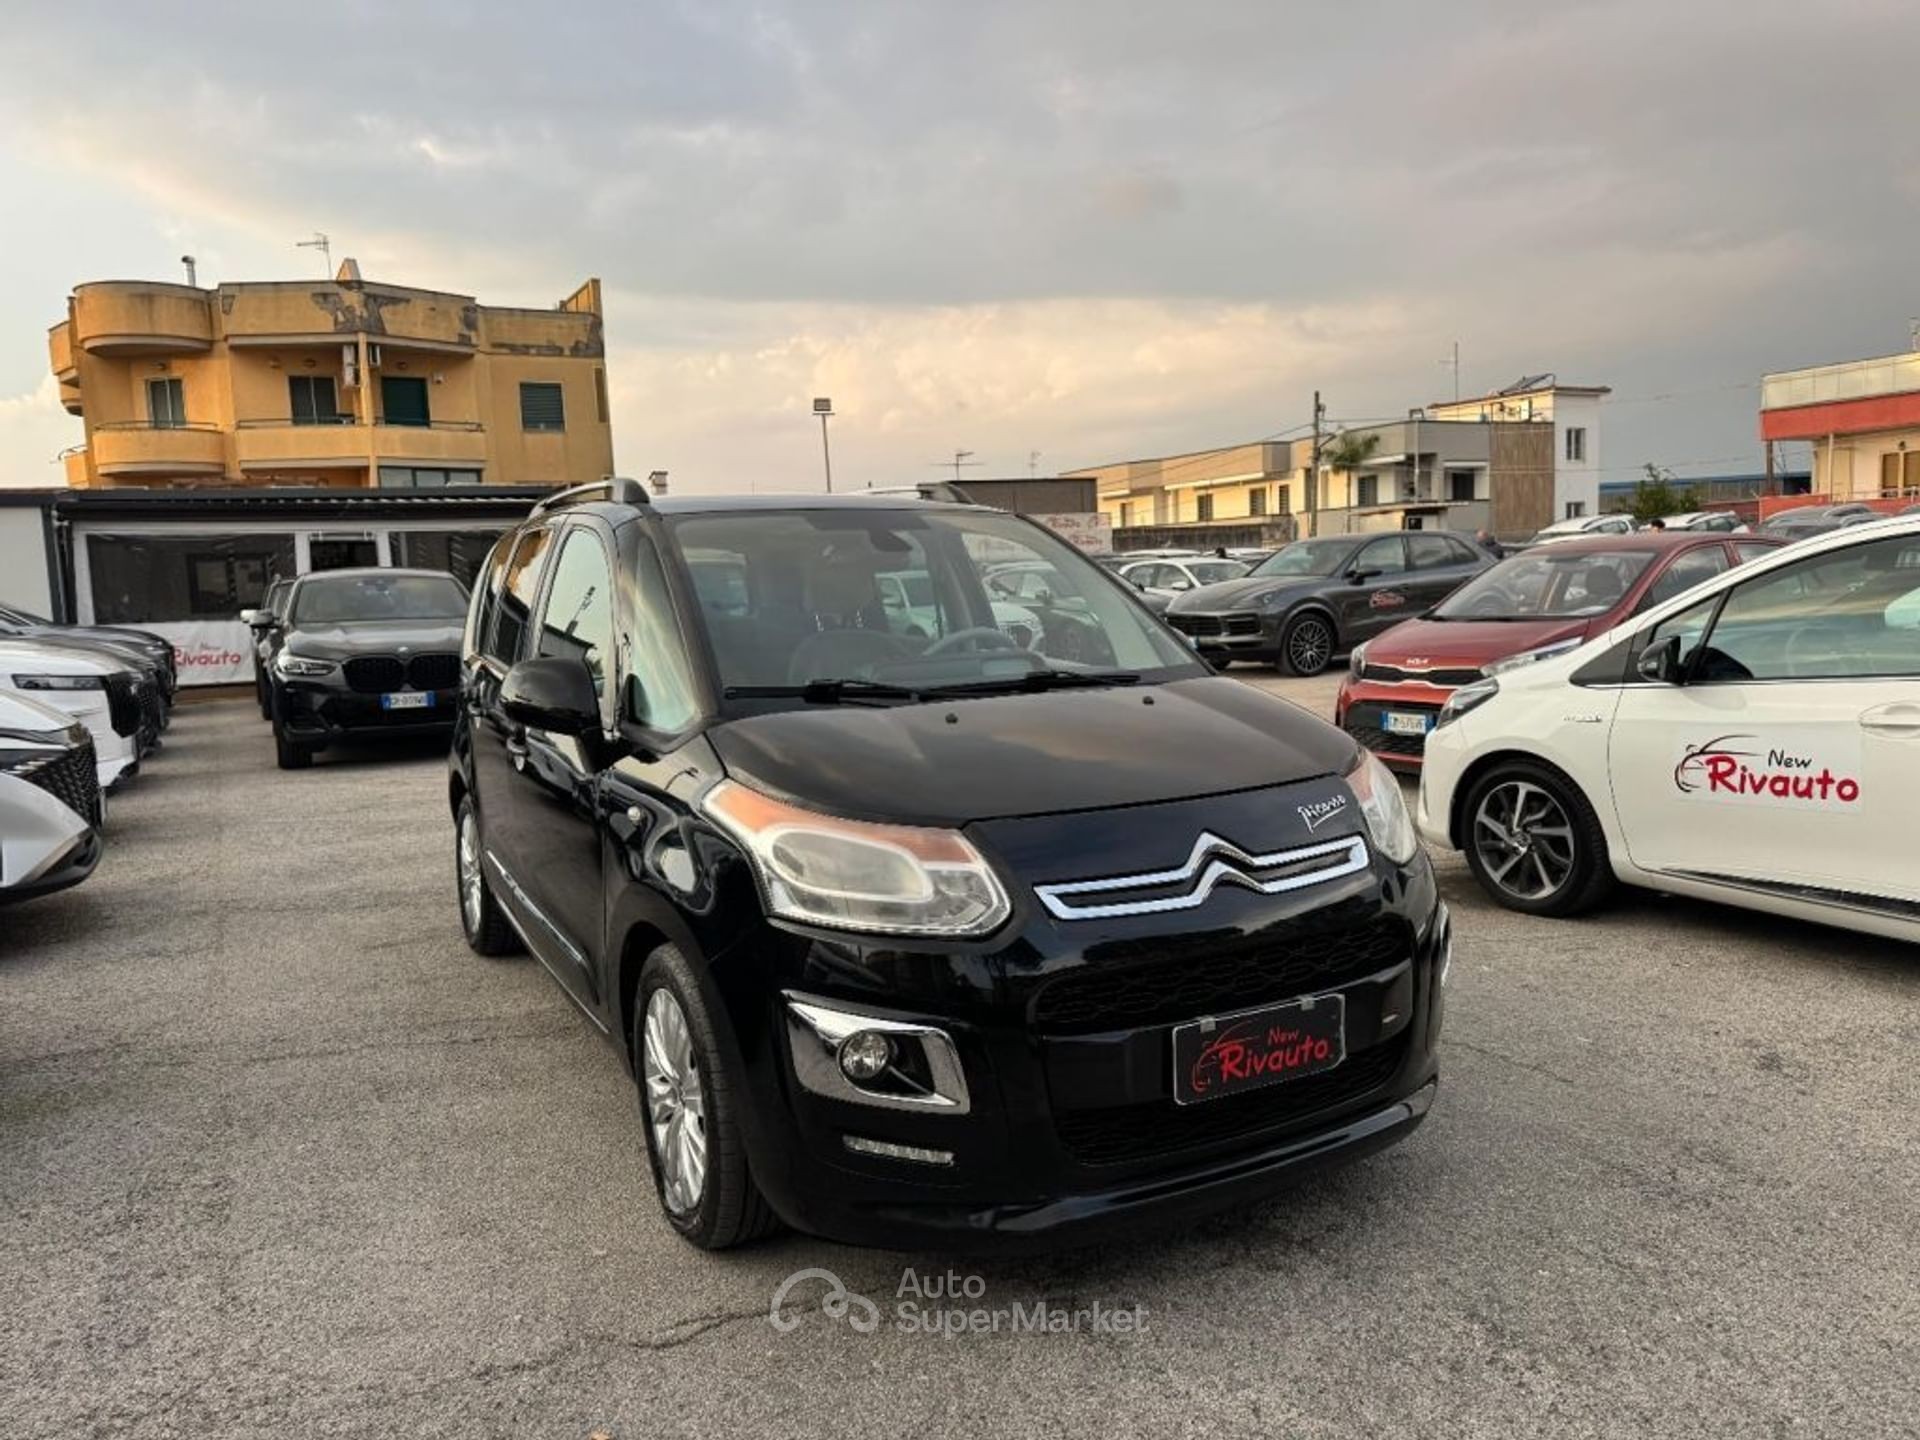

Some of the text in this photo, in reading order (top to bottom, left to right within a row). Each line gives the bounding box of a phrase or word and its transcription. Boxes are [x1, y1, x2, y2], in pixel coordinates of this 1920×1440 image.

[1768, 749, 1813, 769] New
[1705, 755, 1860, 802] Rivauto
[1268, 1026, 1299, 1046] New
[1219, 1034, 1329, 1084] Rivauto
